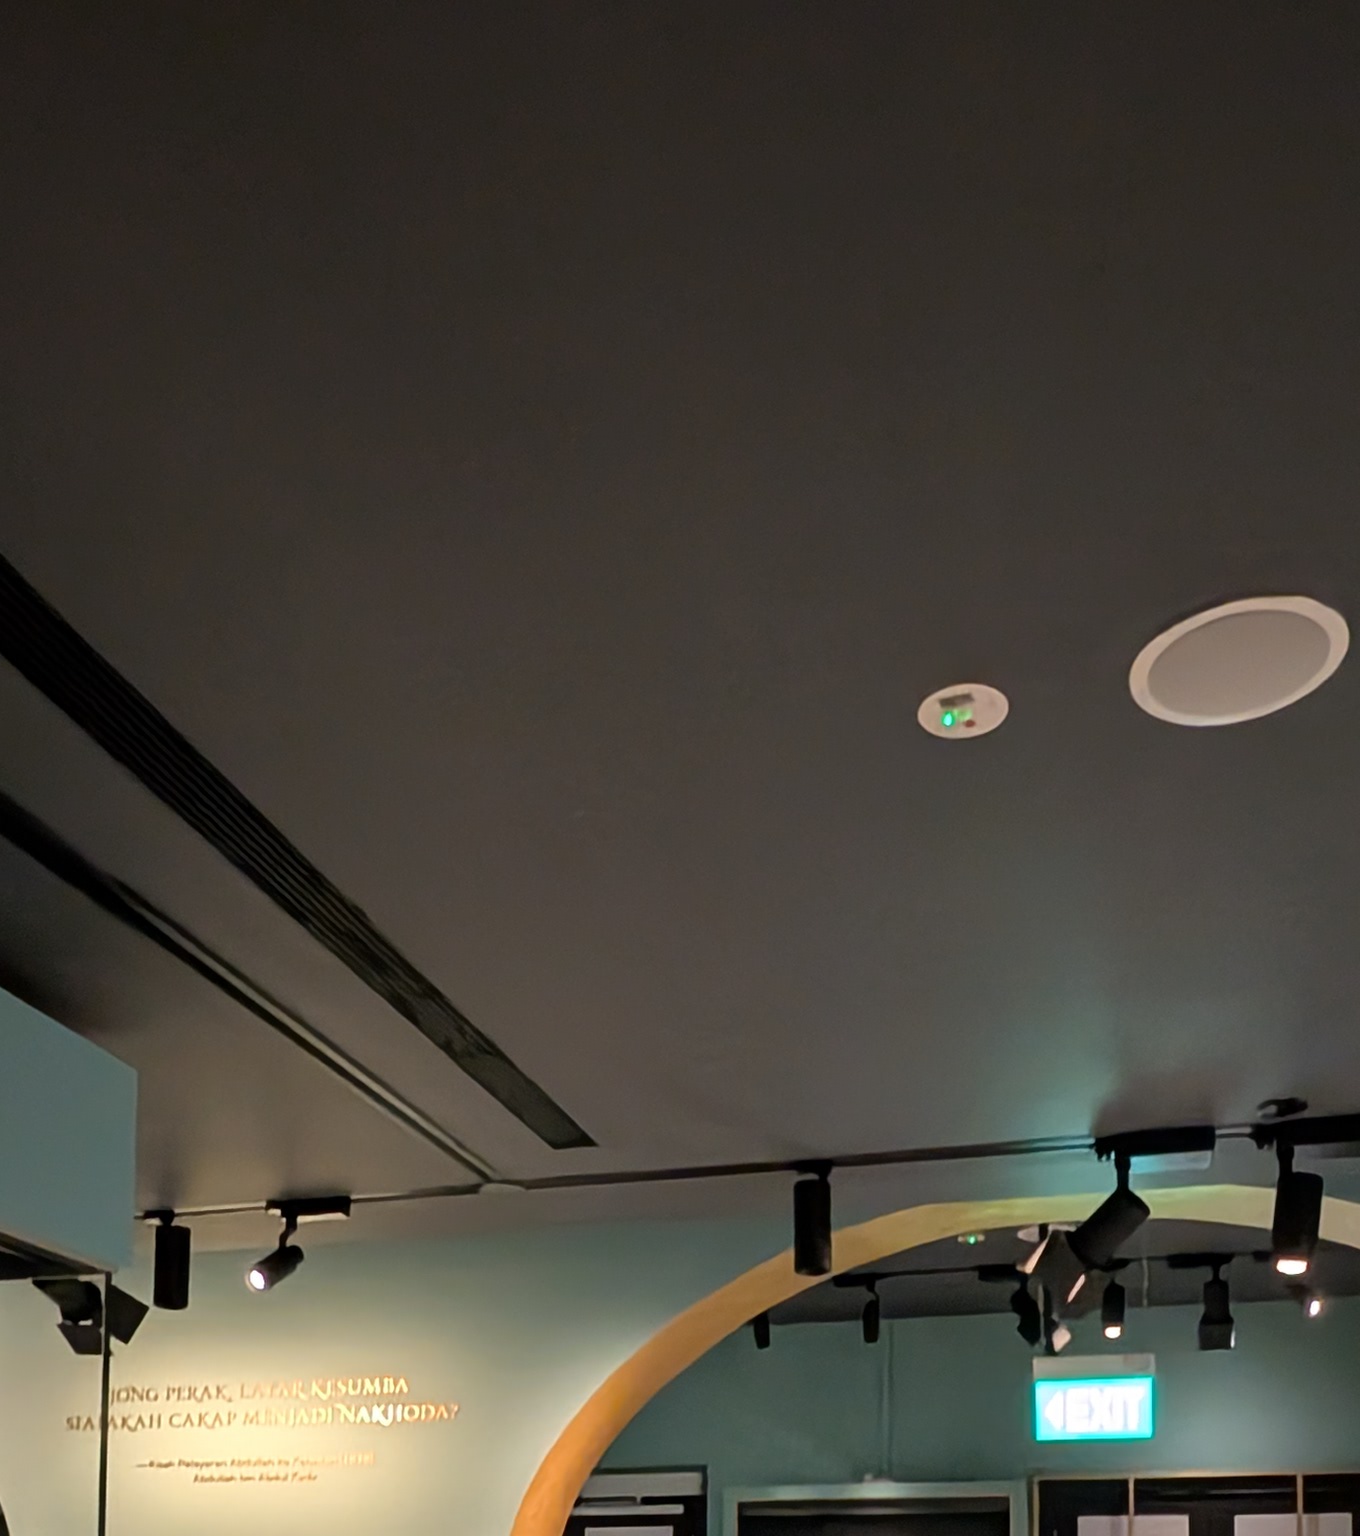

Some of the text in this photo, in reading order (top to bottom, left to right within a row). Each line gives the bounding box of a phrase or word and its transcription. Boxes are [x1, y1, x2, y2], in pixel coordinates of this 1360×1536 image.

[110, 1384, 159, 1406] JONG
[1066, 1385, 1145, 1433] EXIT
[66, 1412, 161, 1433] SIAAKAH
[168, 1412, 237, 1429] CAKAP
